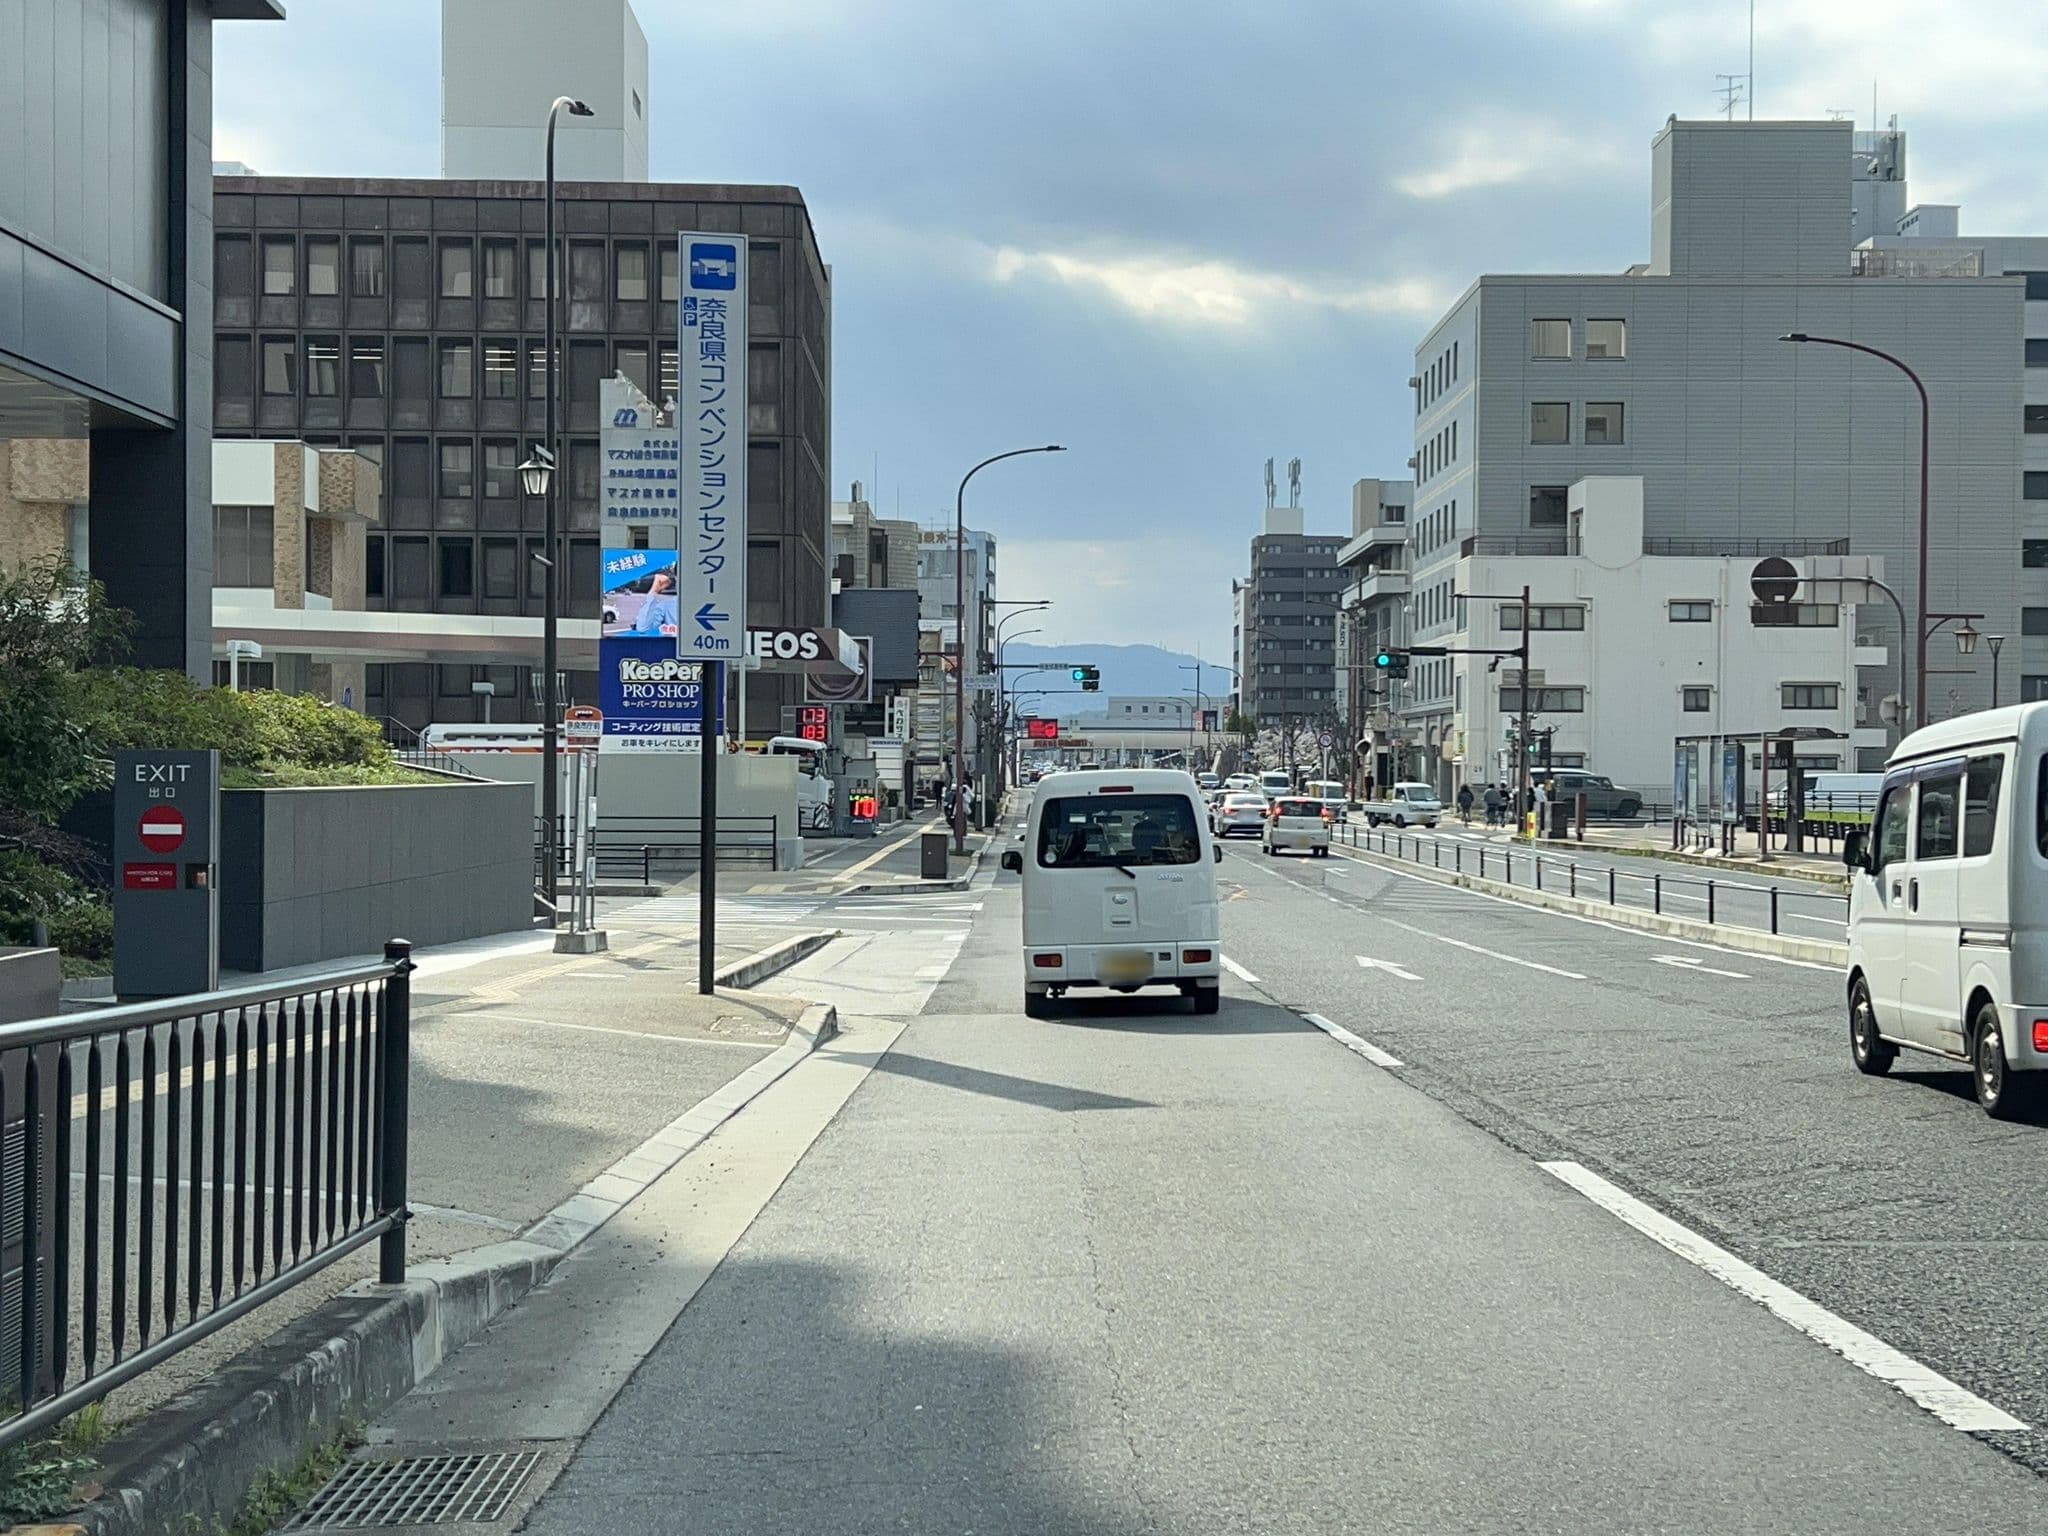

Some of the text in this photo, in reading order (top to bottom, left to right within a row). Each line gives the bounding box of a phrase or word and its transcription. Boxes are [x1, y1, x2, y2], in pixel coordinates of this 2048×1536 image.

[698, 297, 728, 594] 奈良県コンベンションセンター
[606, 553, 647, 574] 未経験
[693, 635, 730, 650] 40m
[746, 631, 819, 659] EOS
[621, 660, 702, 681] KeePer
[623, 684, 700, 698] PRO SHOP
[622, 700, 698, 709] キーパープロショップ
[802, 708, 826, 723] 173
[802, 725, 826, 740] 183
[135, 764, 191, 782] EXIT
[148, 787, 176, 798] 出口
